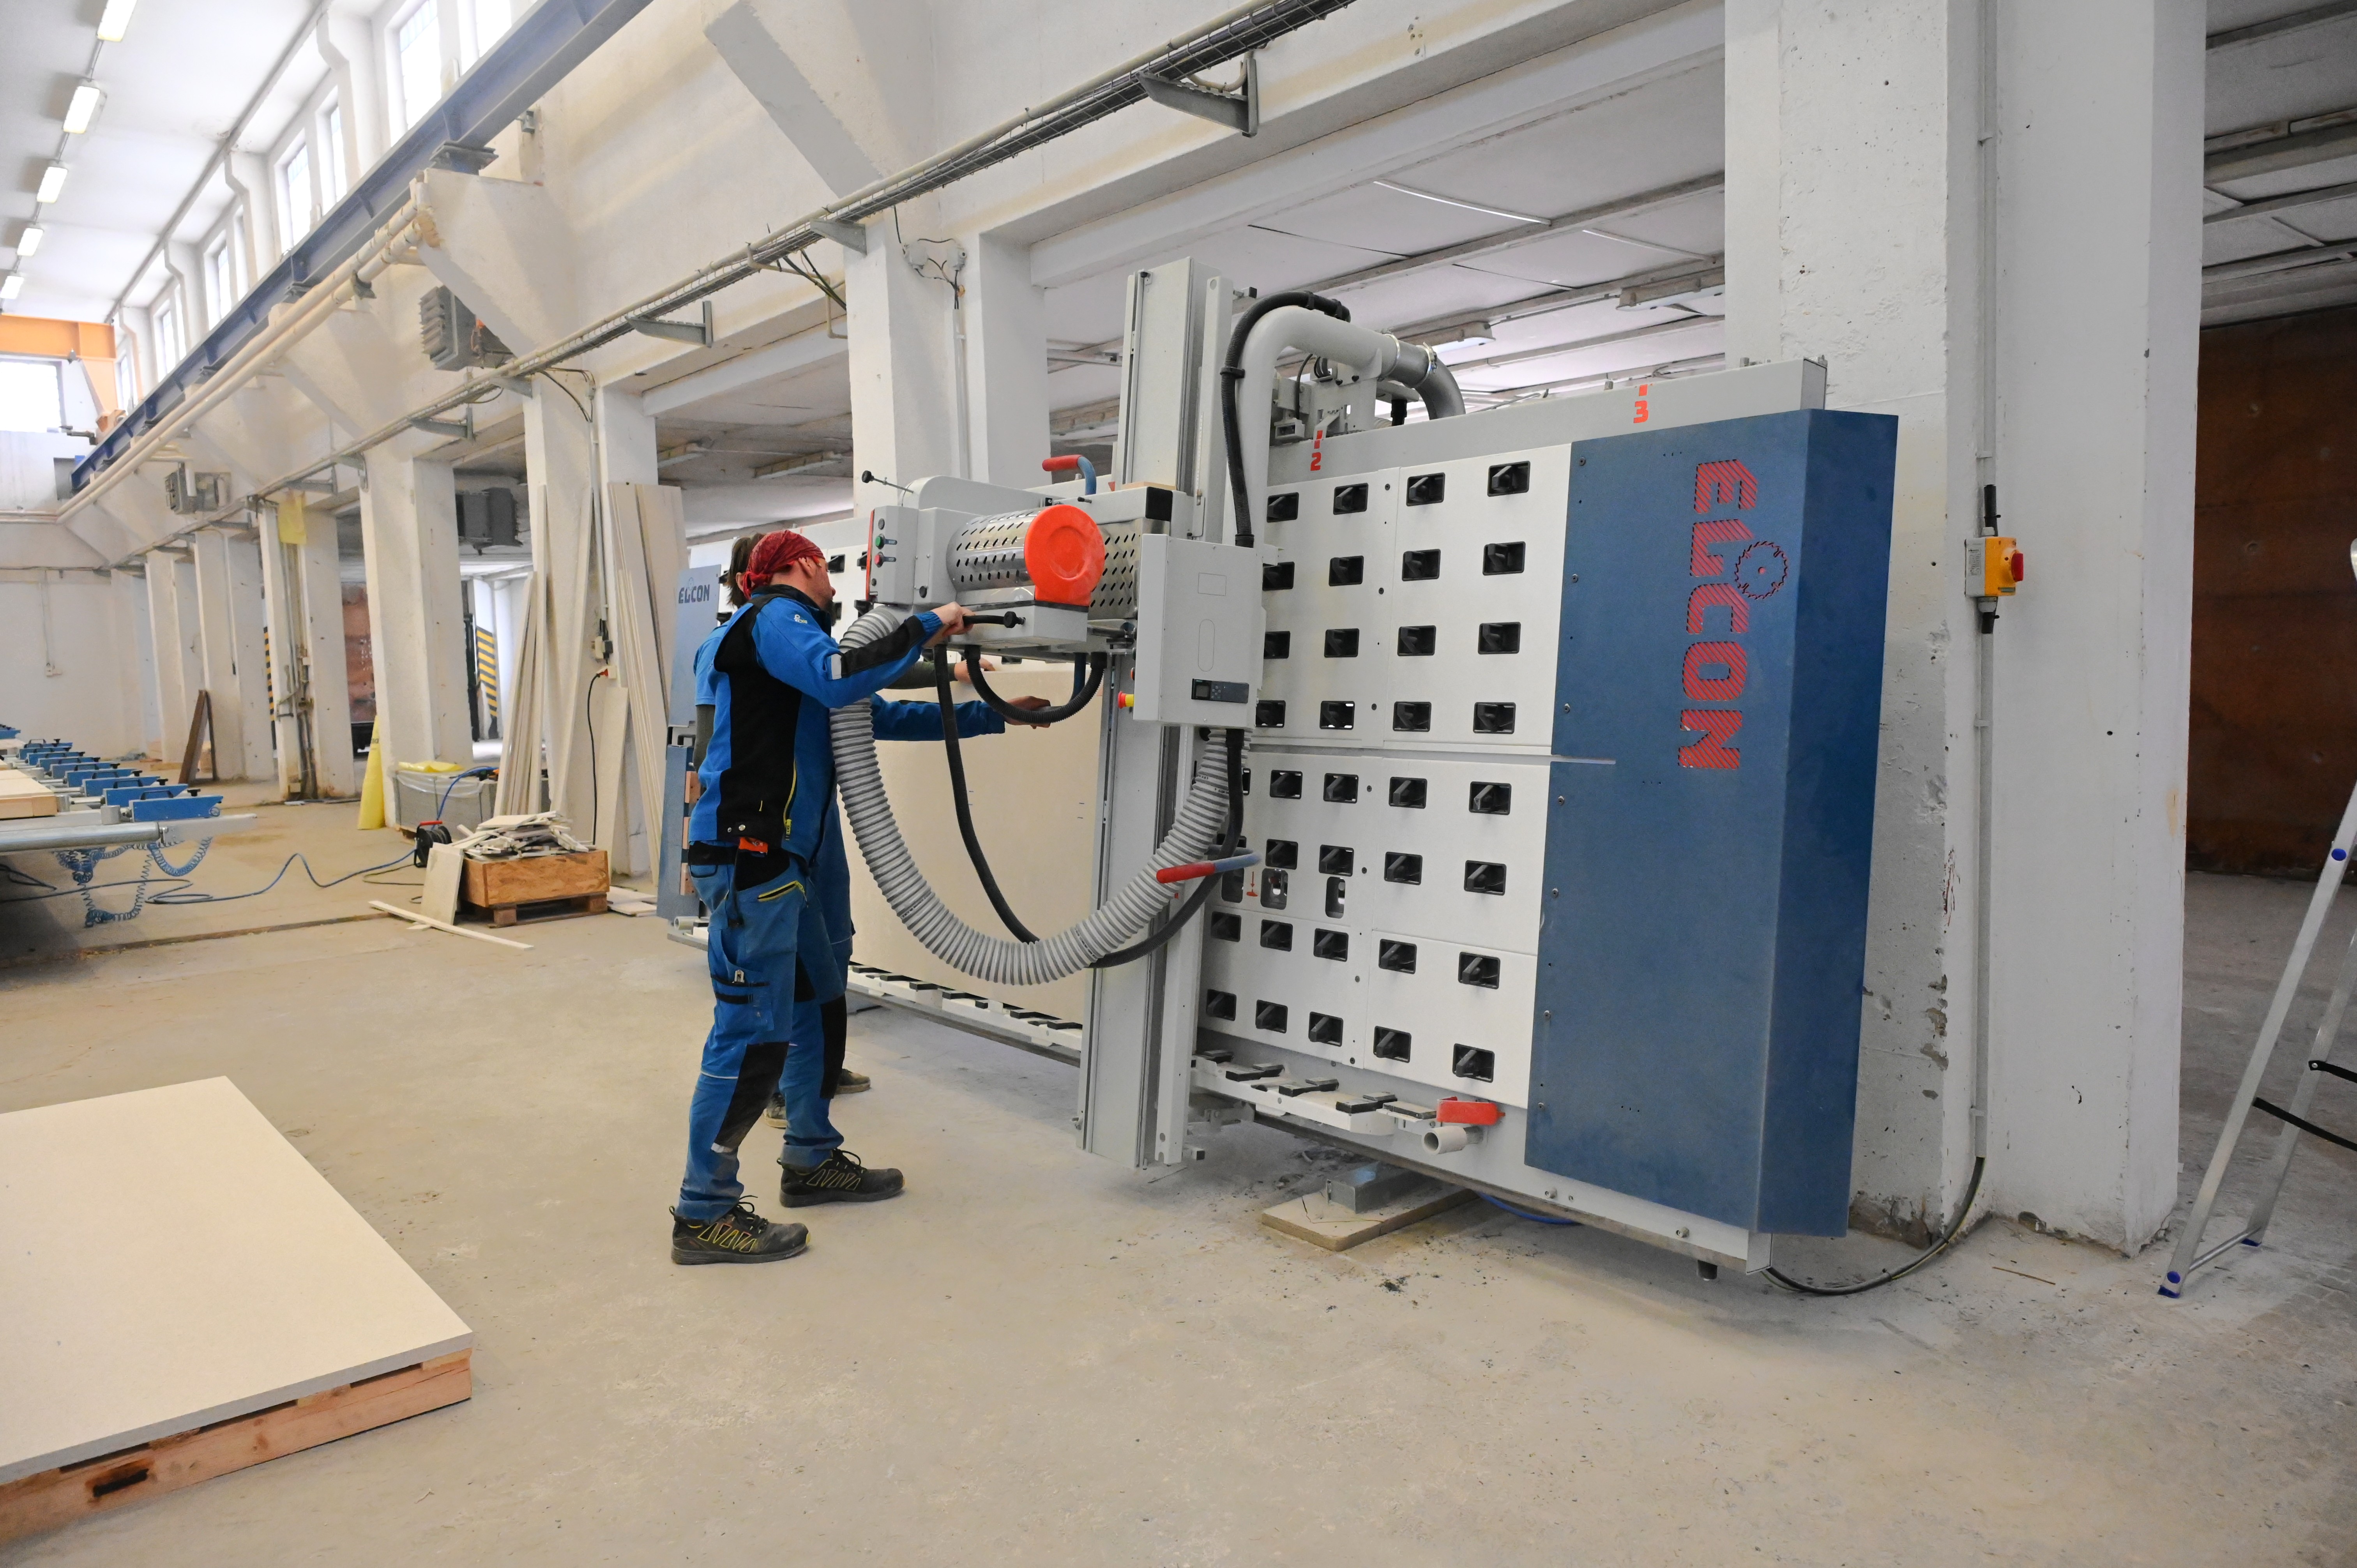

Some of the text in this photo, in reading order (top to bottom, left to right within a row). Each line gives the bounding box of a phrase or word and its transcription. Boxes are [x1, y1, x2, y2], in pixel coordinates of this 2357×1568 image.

[1633, 400, 1648, 424] 3
[1310, 452, 1322, 471] 2
[678, 584, 710, 603] ELCON
[1678, 459, 1758, 770] ELCON
